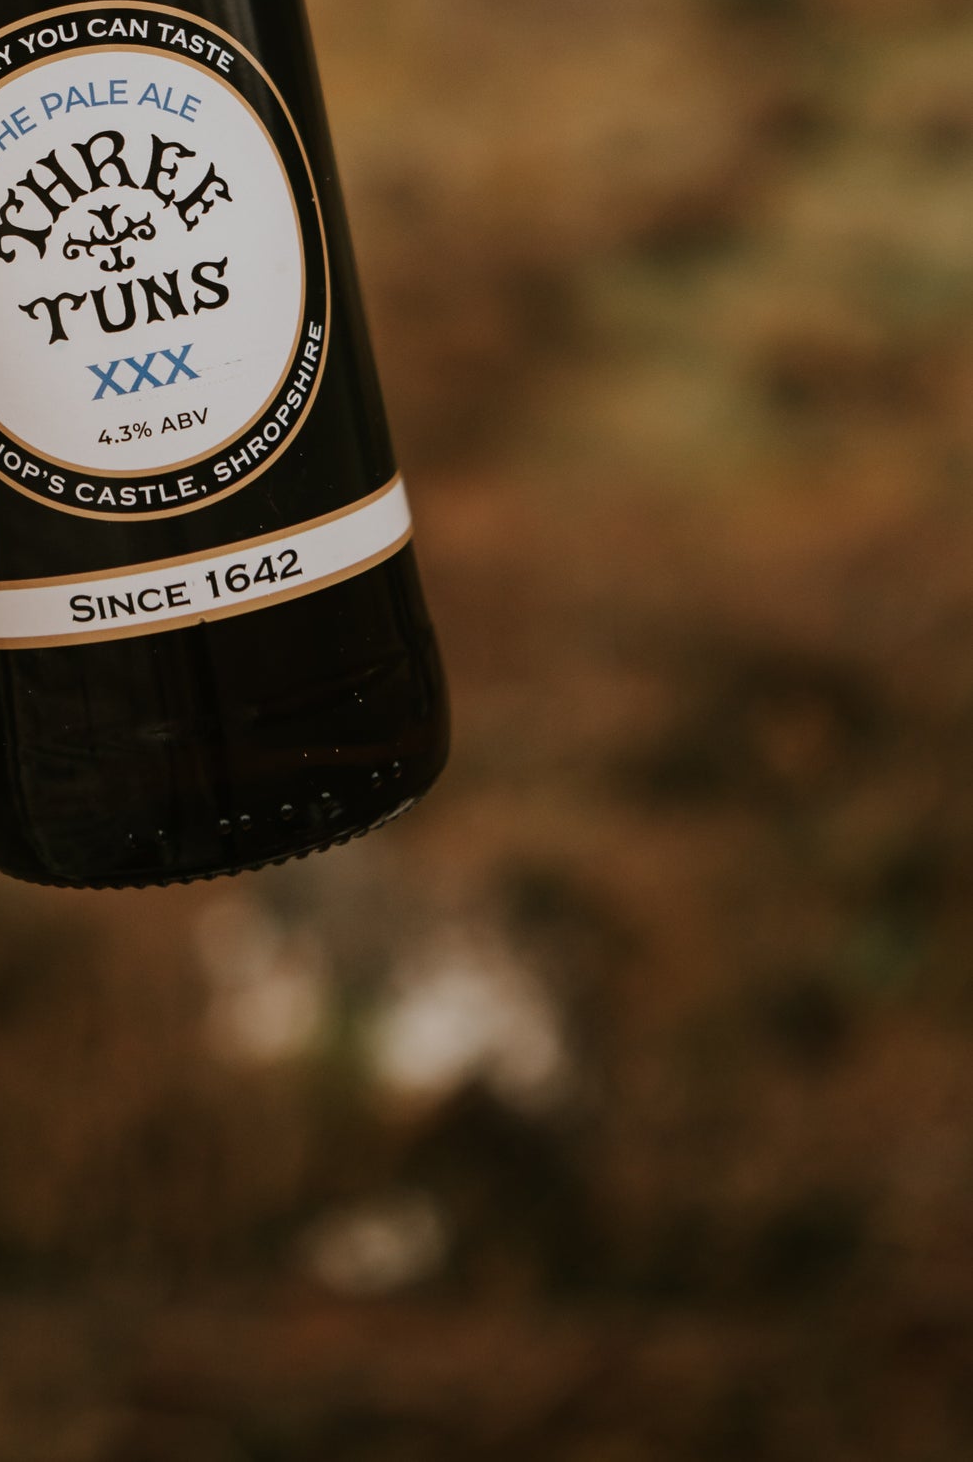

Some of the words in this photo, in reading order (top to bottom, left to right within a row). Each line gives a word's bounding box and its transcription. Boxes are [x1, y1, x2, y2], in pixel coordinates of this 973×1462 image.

[18, 21, 80, 55] YOU
[86, 17, 149, 39] CAN
[157, 21, 235, 73] TASTE
[39, 79, 129, 121] PALE
[137, 82, 202, 123] ALE
[17, 256, 230, 345] TUNS
[84, 343, 201, 402] XXX
[75, 474, 208, 507] CASTLE,
[213, 321, 324, 483] SHROPSHIRE
[97, 421, 154, 447] 4.3%
[159, 406, 210, 434] ABV
[205, 547, 304, 601] 1642
